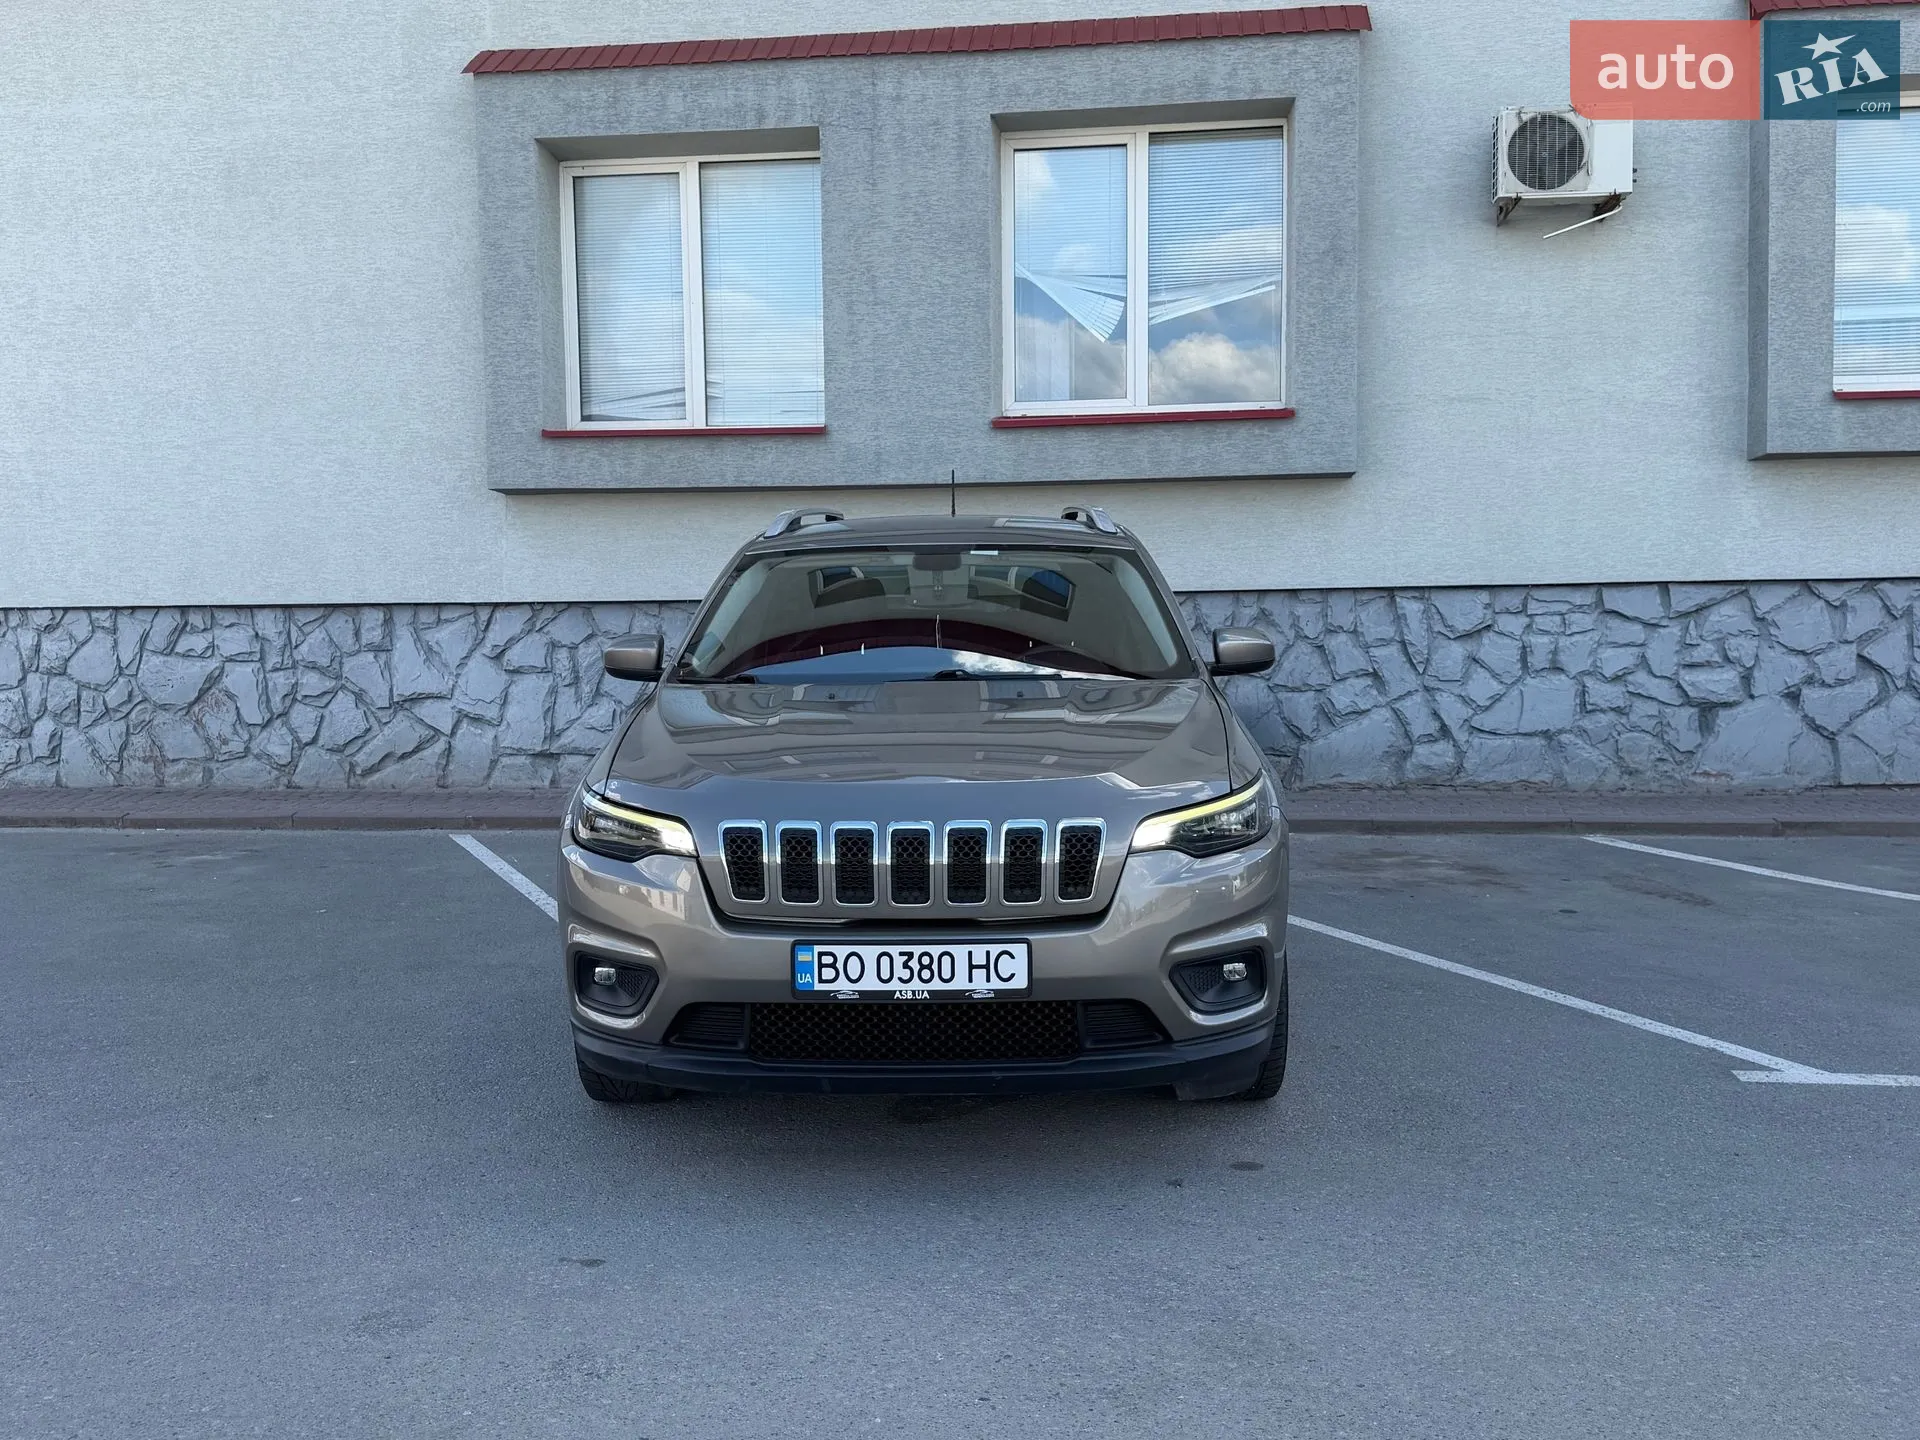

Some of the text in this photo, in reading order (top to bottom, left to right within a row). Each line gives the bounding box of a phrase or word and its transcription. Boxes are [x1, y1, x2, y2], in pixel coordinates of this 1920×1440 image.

[817, 950, 1016, 984] BO 0380 HC
[797, 974, 813, 984] UA
[894, 990, 930, 1000] ASB.UA
